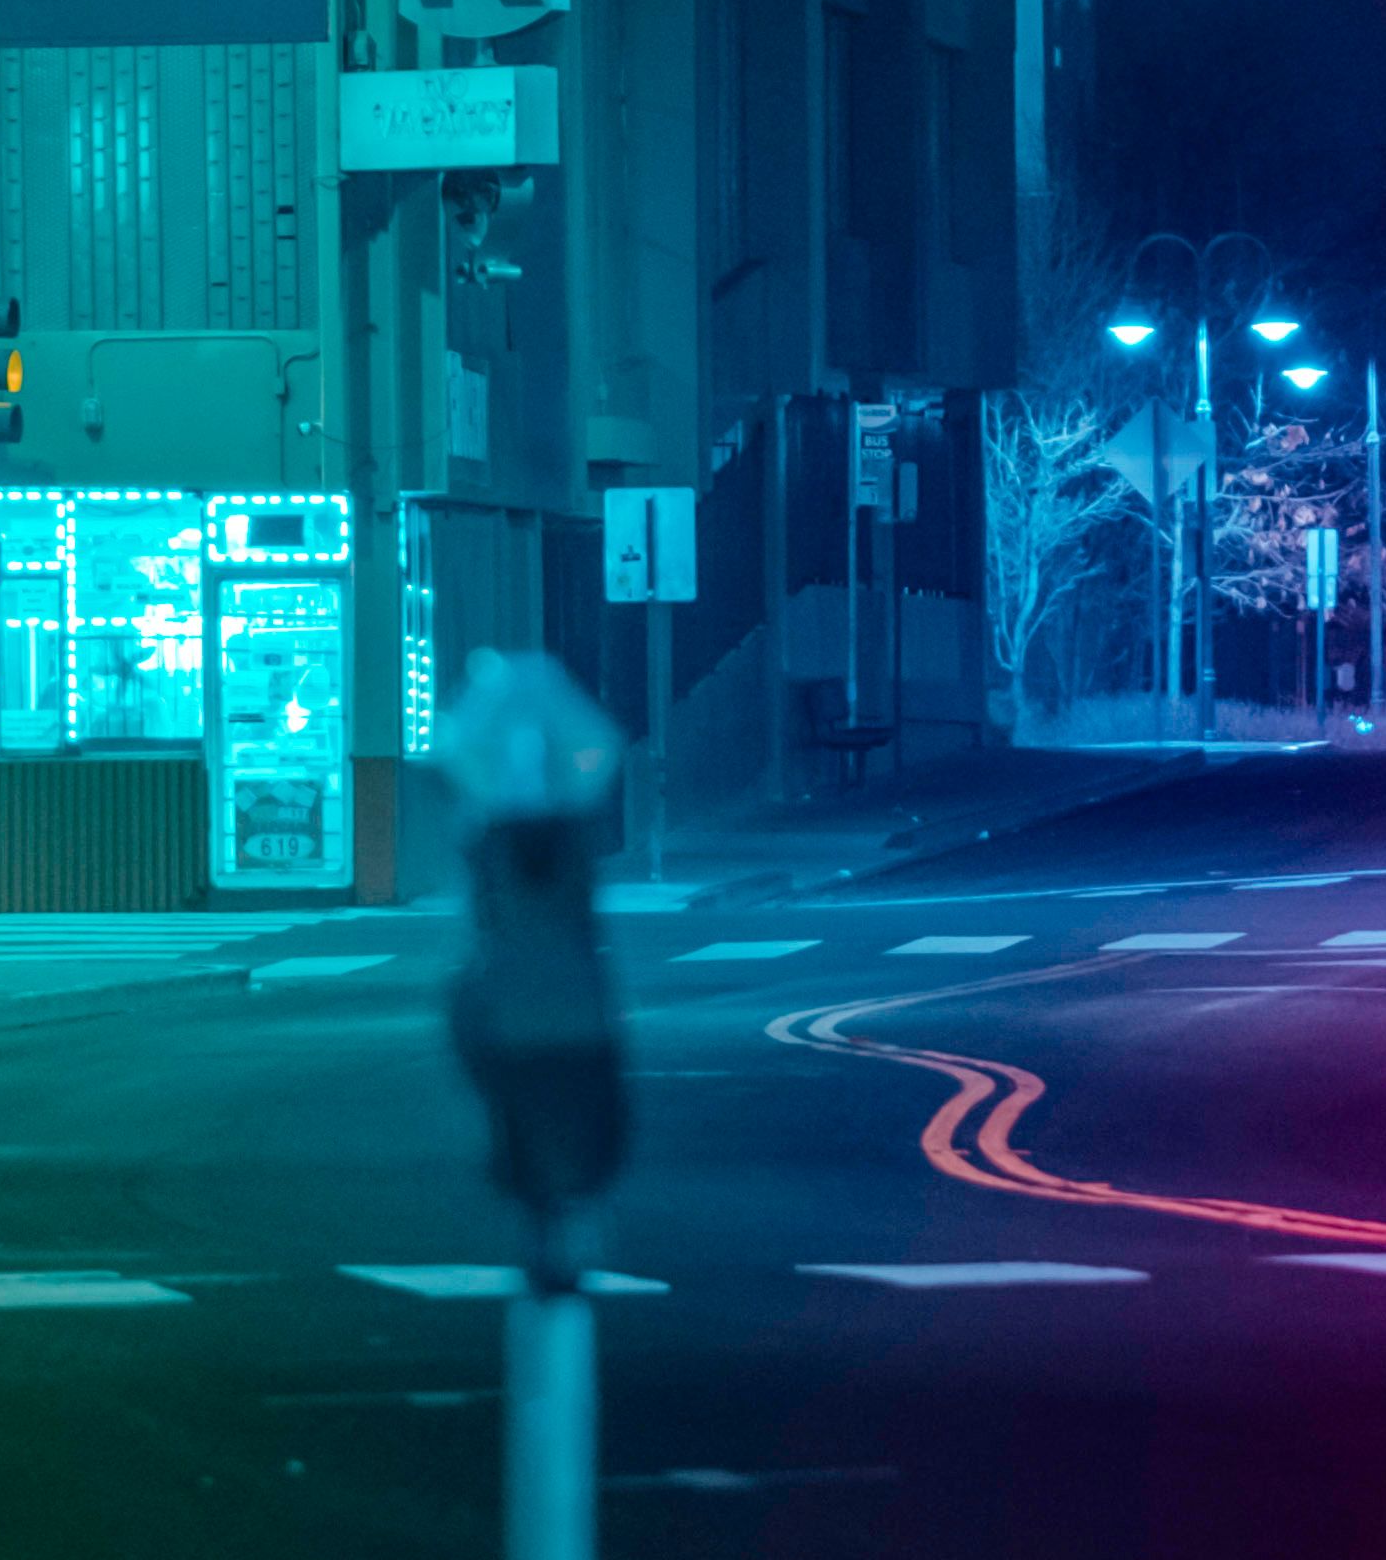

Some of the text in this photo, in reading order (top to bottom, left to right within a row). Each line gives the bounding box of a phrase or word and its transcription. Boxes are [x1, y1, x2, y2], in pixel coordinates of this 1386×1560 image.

[864, 435, 889, 447] BUS
[861, 448, 893, 459] STOP
[260, 837, 300, 857] 619
